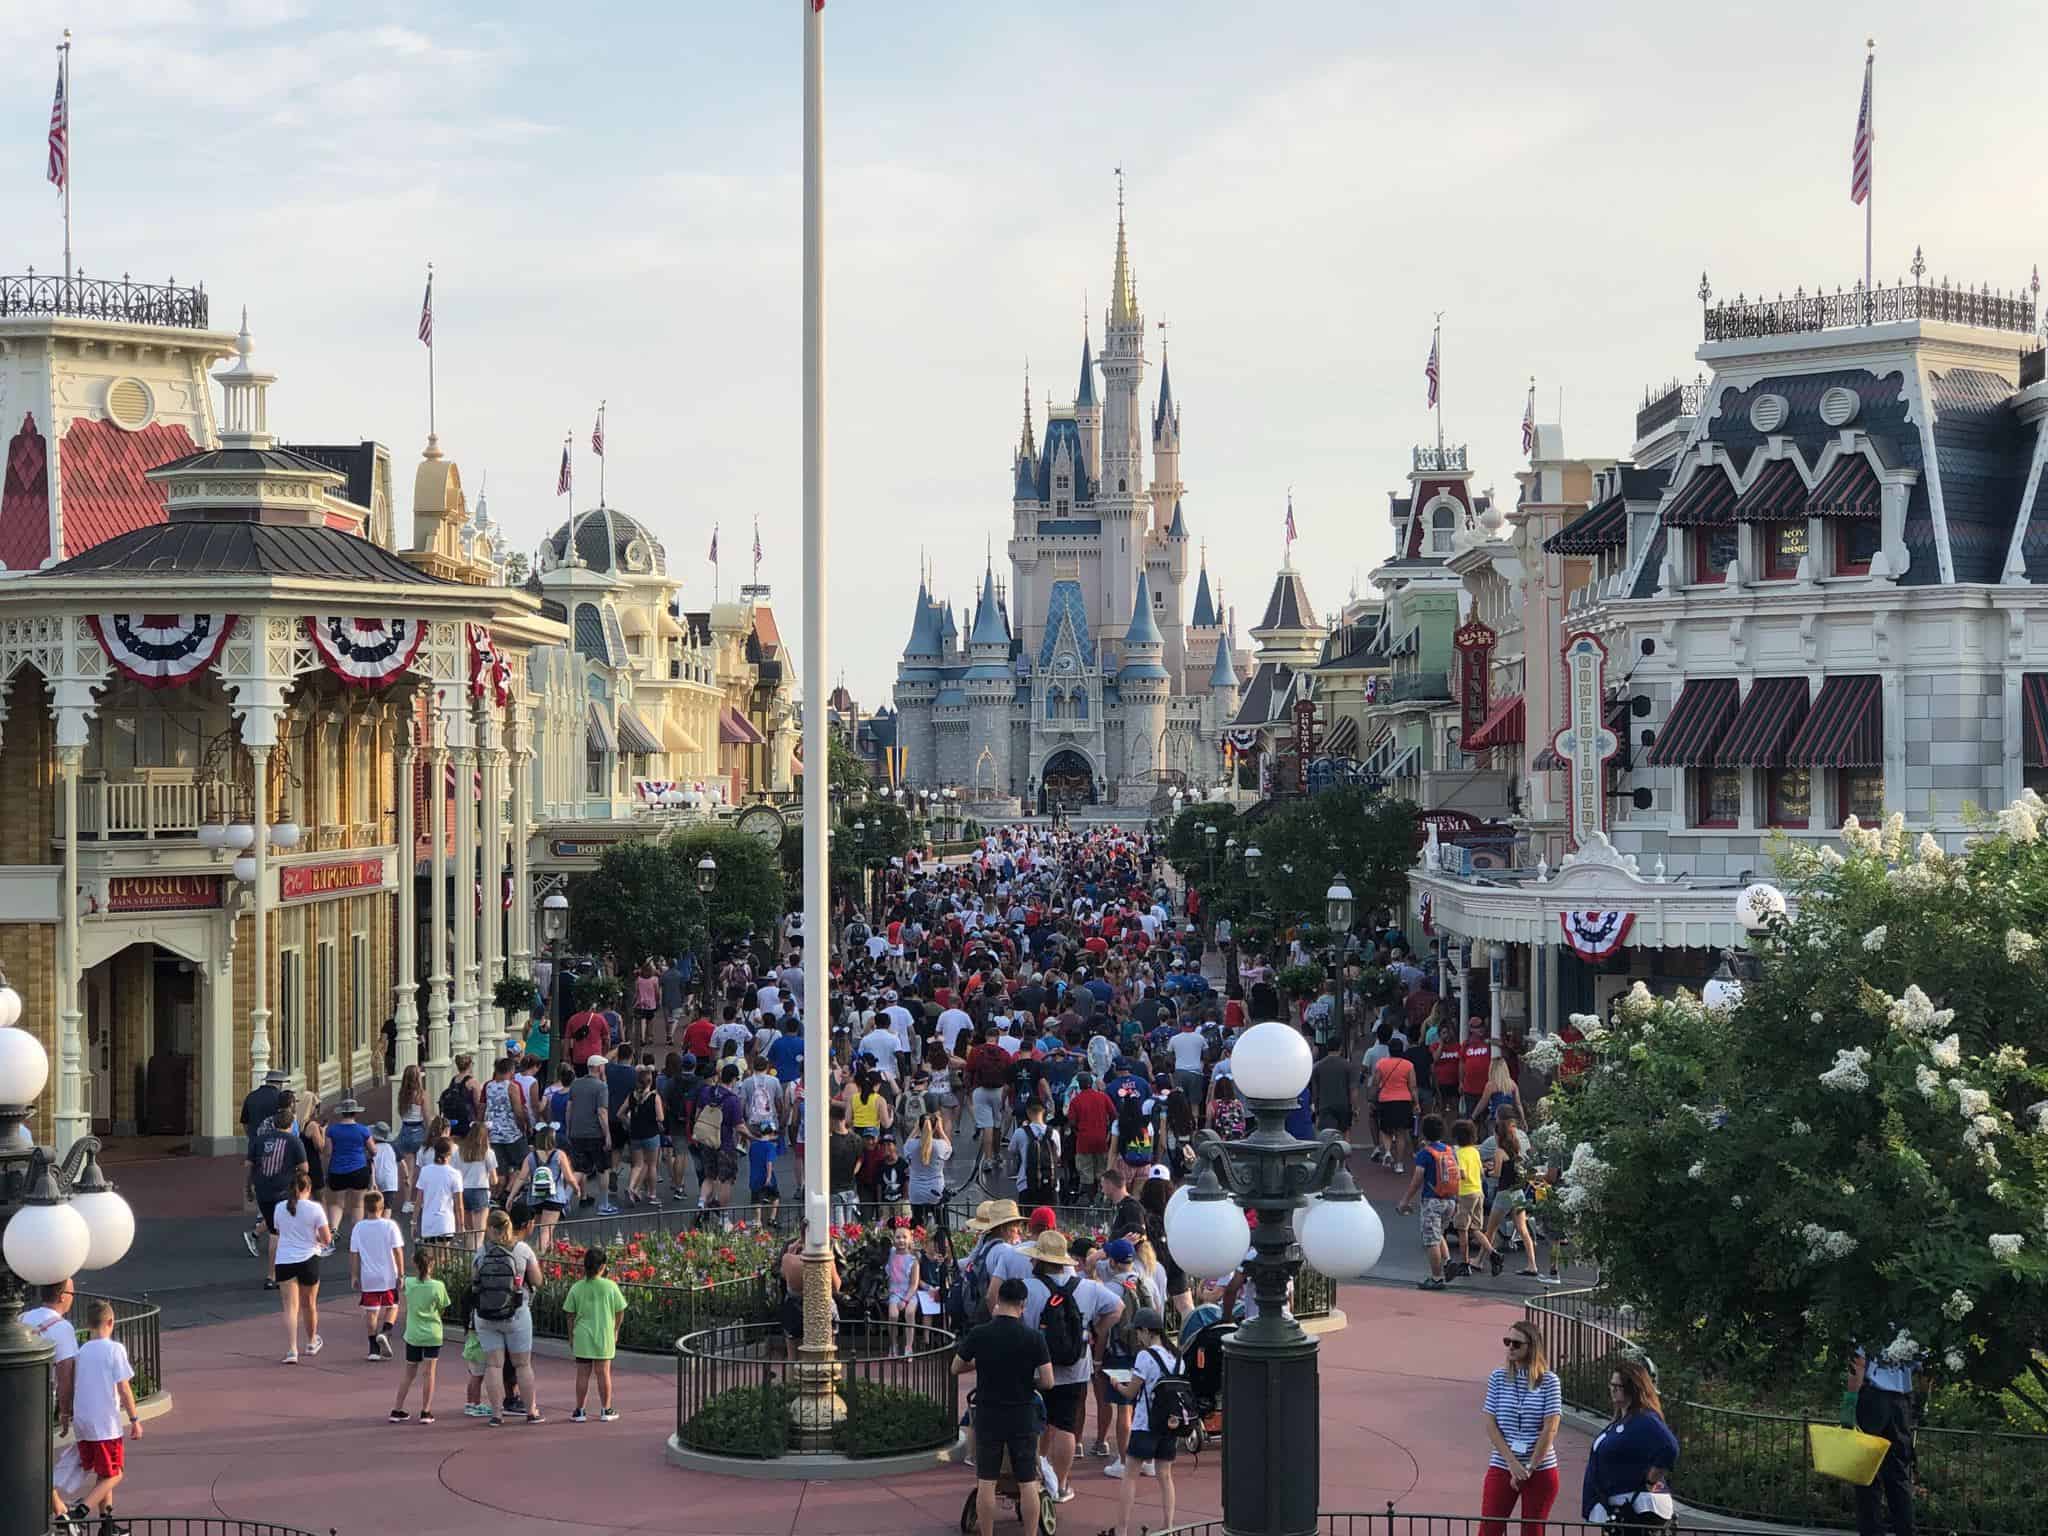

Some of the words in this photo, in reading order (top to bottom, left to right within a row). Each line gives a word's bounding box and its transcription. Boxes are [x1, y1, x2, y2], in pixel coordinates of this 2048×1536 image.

[1783, 529, 1805, 539] ROY
[1781, 545, 1809, 554] DISNE
[1458, 631, 1491, 643] MAIN
[1578, 655, 1595, 836] CONFECTIONERY
[1416, 820, 1472, 832] IEMA
[312, 863, 363, 891] EMPORIUM
[110, 875, 210, 897] PORIUM
